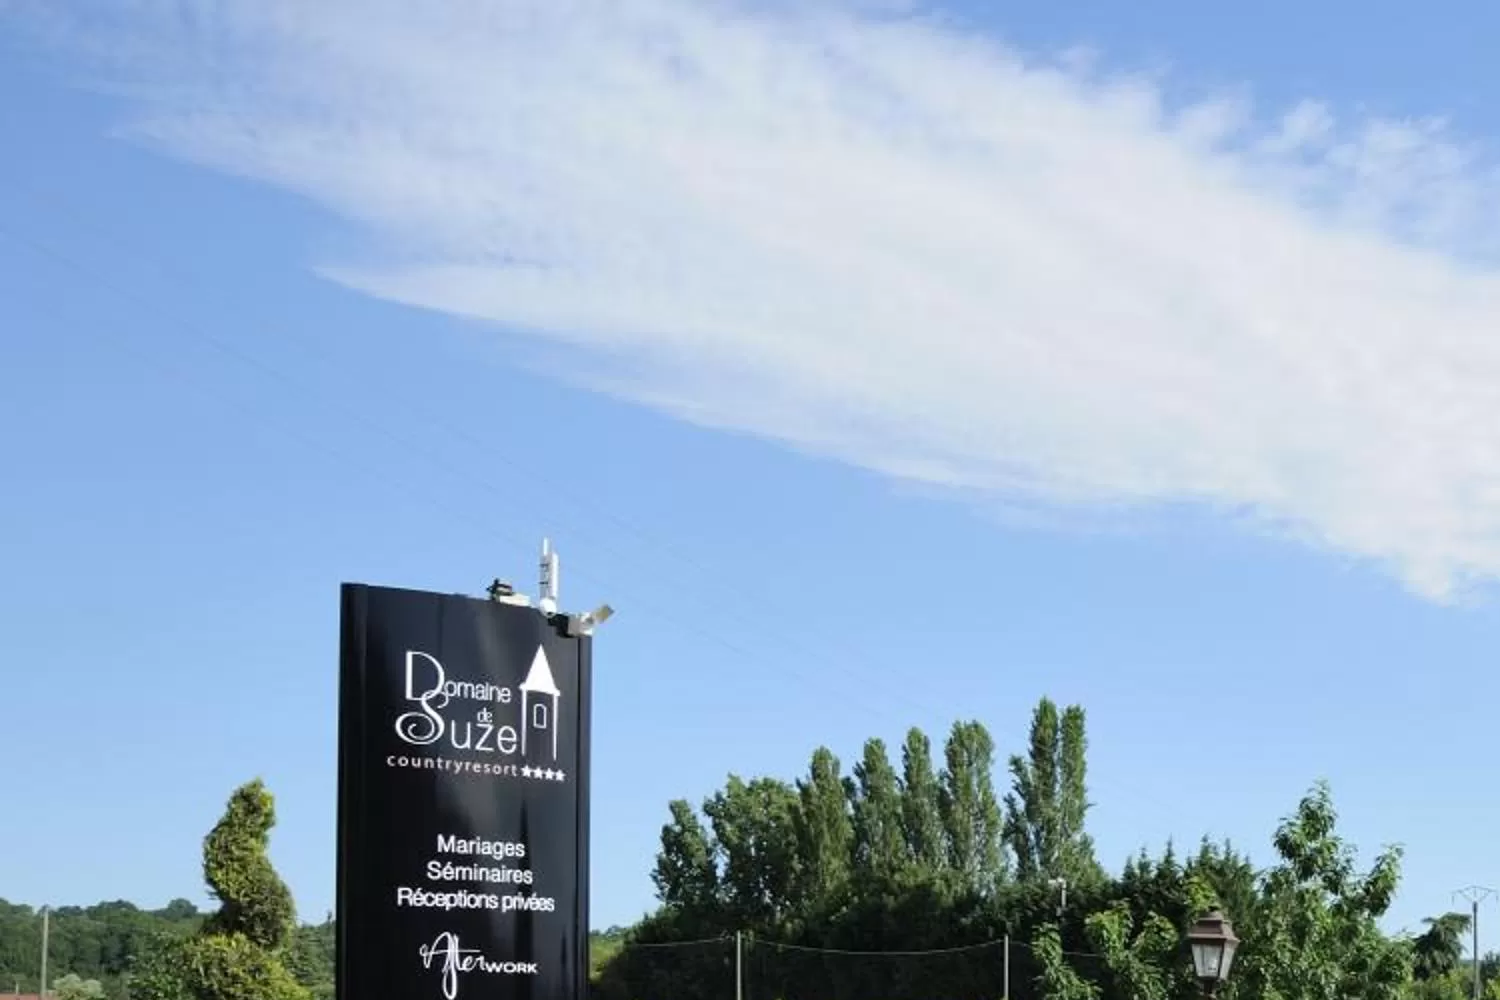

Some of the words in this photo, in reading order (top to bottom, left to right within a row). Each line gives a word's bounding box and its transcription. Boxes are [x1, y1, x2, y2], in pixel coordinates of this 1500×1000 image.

[405, 650, 512, 703] Domaine
[477, 708, 493, 723] de
[436, 834, 526, 860] Mariages
[426, 861, 533, 885] Séminaires
[397, 887, 499, 911] Réceptions
[501, 892, 556, 912] privées
